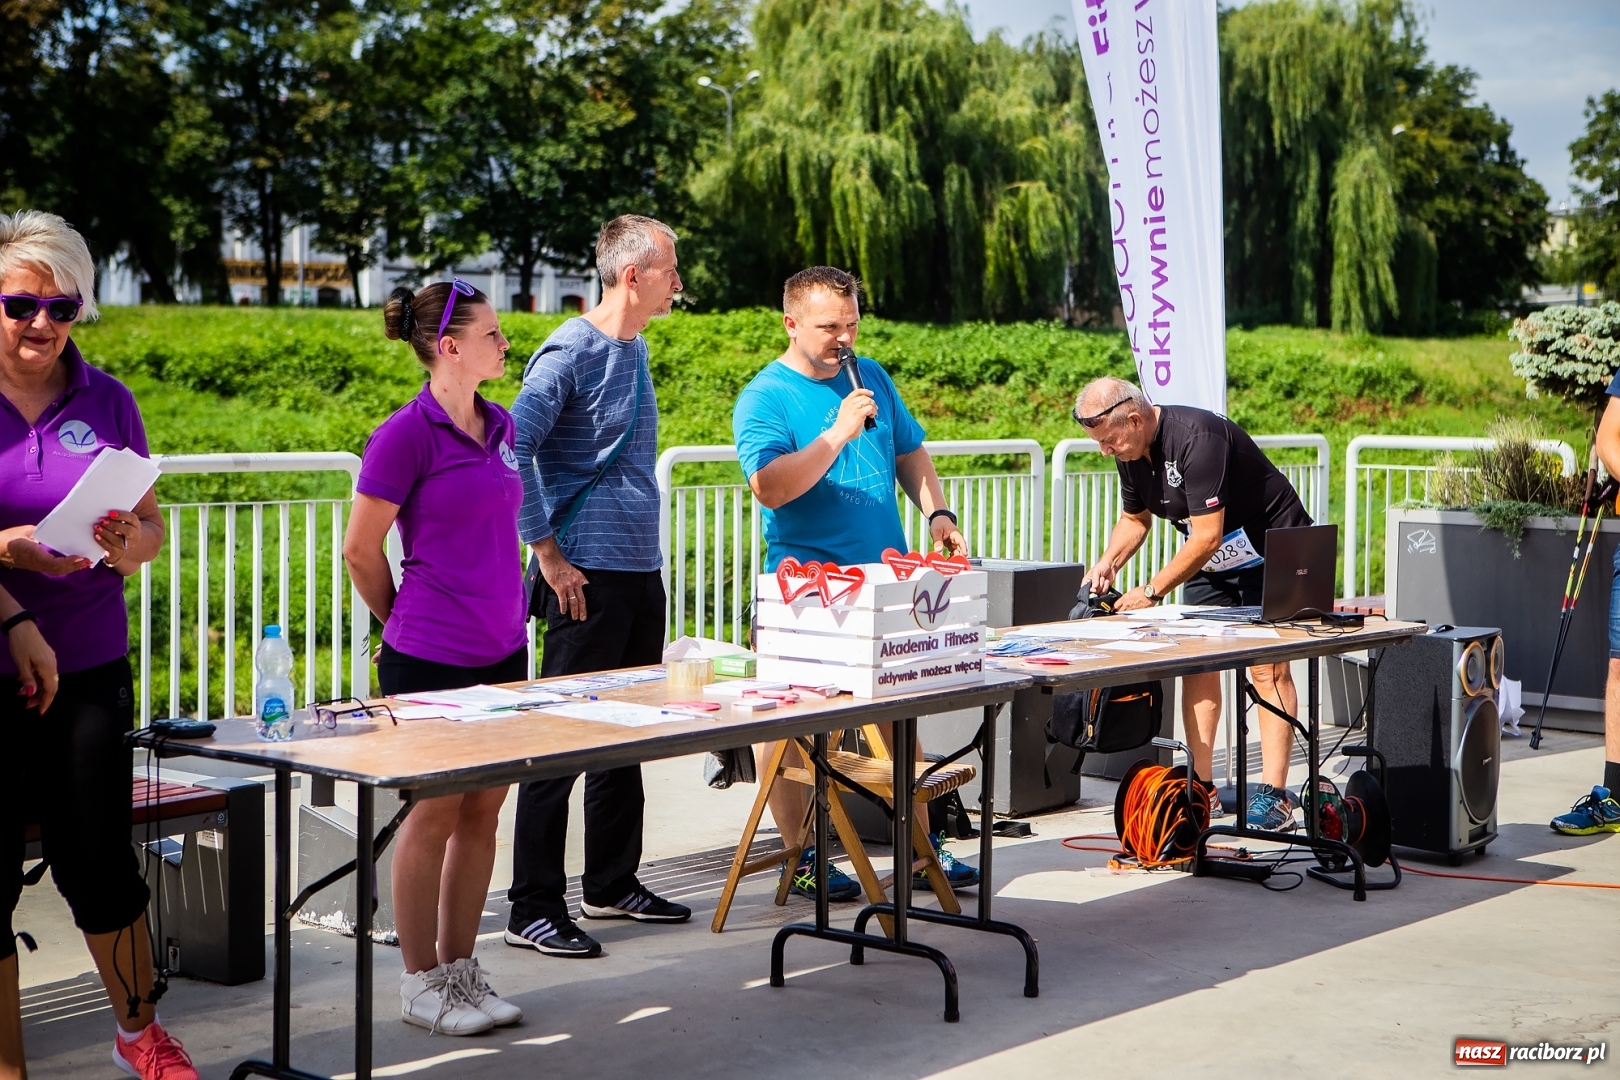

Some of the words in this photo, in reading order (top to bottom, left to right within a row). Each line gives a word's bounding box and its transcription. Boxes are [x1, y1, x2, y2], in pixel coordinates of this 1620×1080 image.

[1134, 15, 1163, 179] możesz
[1143, 185, 1175, 387] aktywnie
[878, 669, 918, 686] aktywnie
[920, 664, 952, 678] możesz
[954, 658, 982, 674] więcej
[880, 636, 939, 658] Akademia
[944, 631, 979, 648] Fitness
